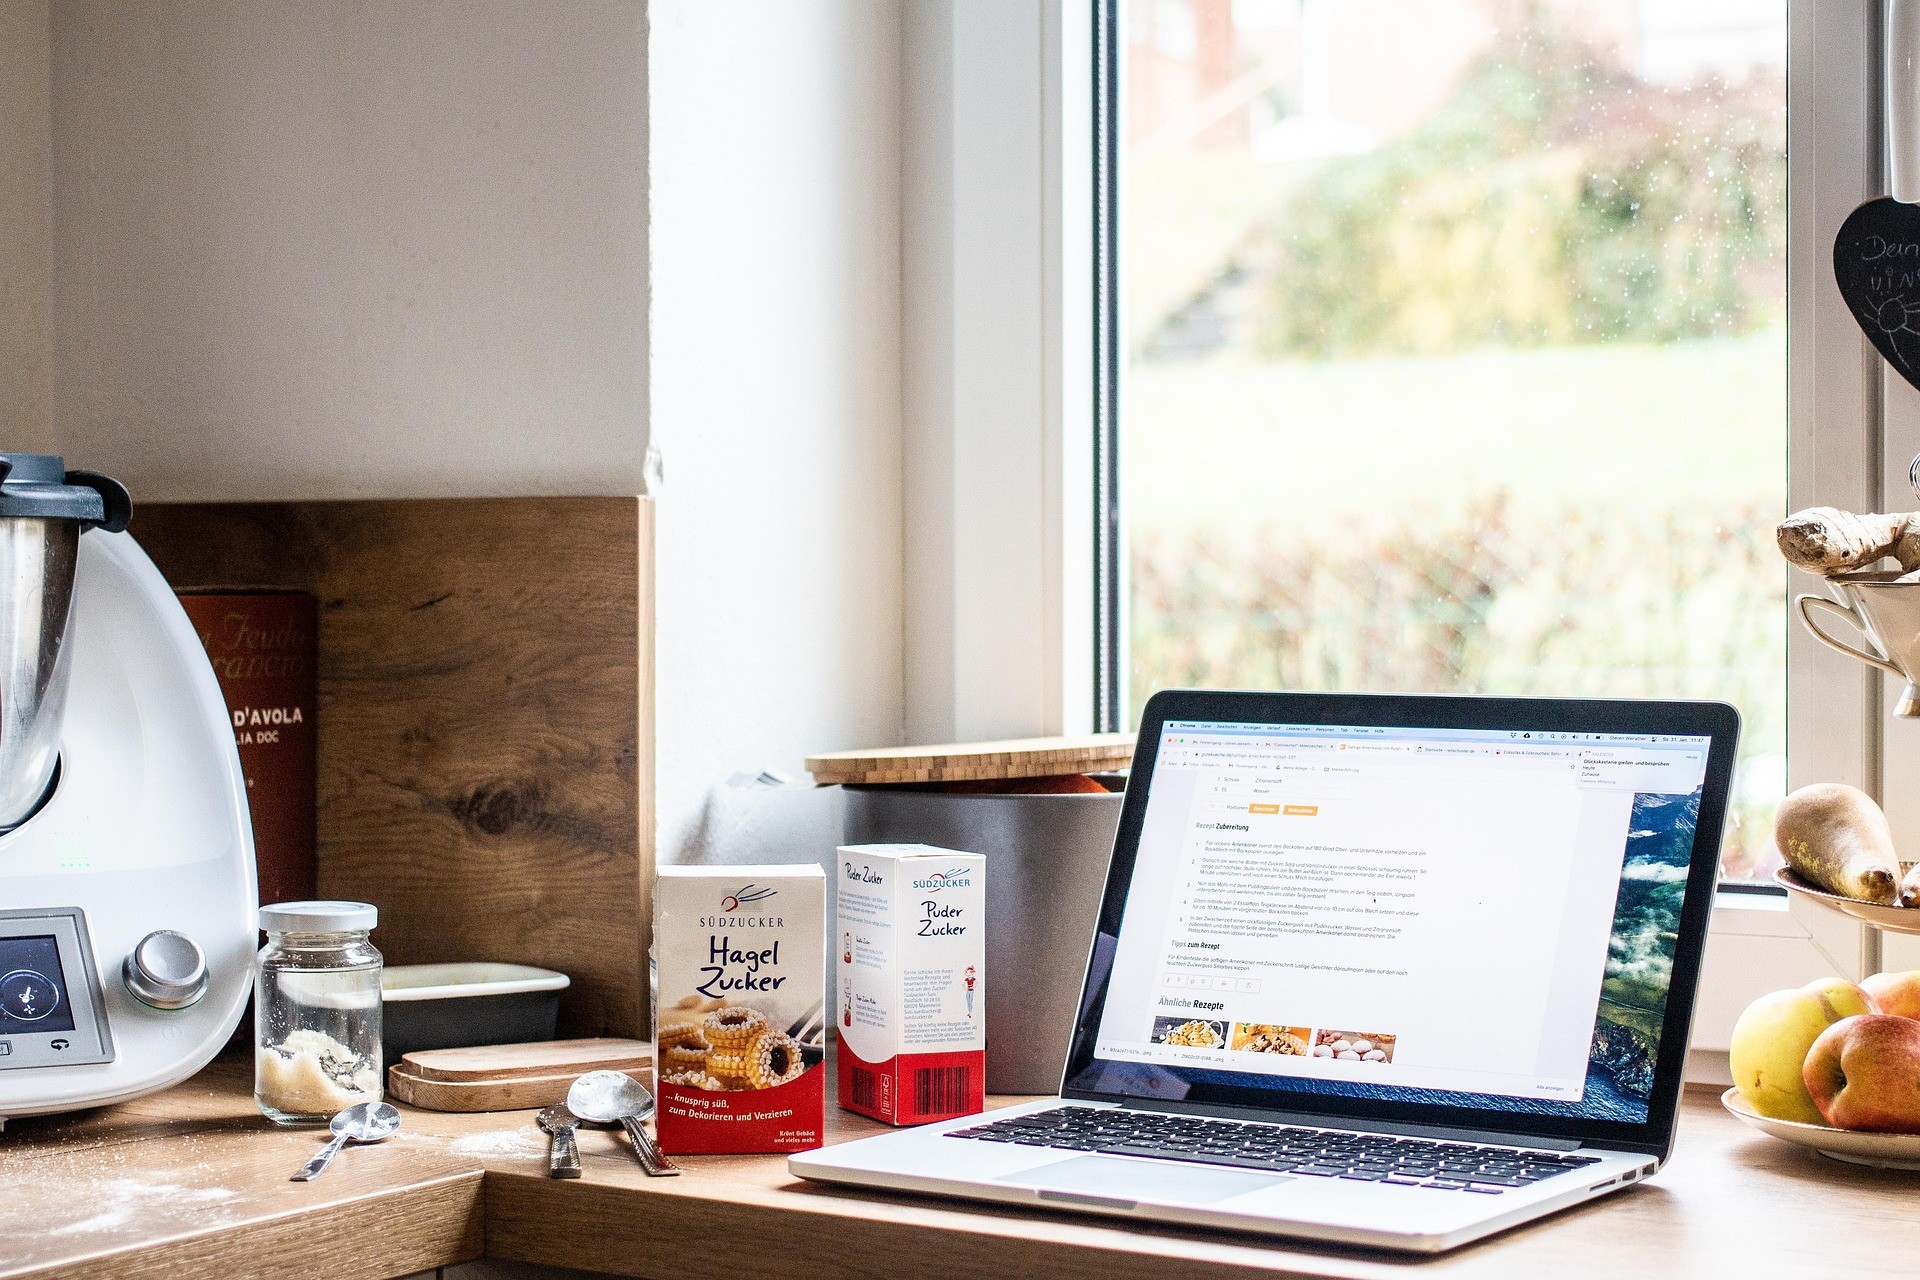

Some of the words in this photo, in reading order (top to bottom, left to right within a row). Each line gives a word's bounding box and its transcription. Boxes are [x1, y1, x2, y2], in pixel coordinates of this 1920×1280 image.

[233, 706, 303, 727] D'AVOLA
[256, 730, 279, 744] DOC
[1195, 823, 1215, 831] Rezept
[1215, 824, 1249, 832] Zubereitung
[845, 862, 861, 881] Puder
[862, 866, 883, 885] Zucker
[920, 900, 963, 918] Puder
[699, 915, 784, 928] SÜDZUCKER
[917, 919, 966, 937] Zucker
[710, 935, 779, 973] Hagel
[1171, 940, 1187, 948] Tipps
[1200, 942, 1220, 951] Rezept
[696, 966, 787, 999] Zucker
[1159, 994, 1192, 1009] Ähnliche
[1192, 999, 1224, 1013] Rezepte
[674, 1093, 710, 1109] knusprig
[711, 1099, 730, 1109] süß,
[668, 1106, 686, 1116] zum
[688, 1109, 733, 1121] Dekorieren
[736, 1113, 752, 1121] und
[754, 1109, 793, 1121] Verzieren
